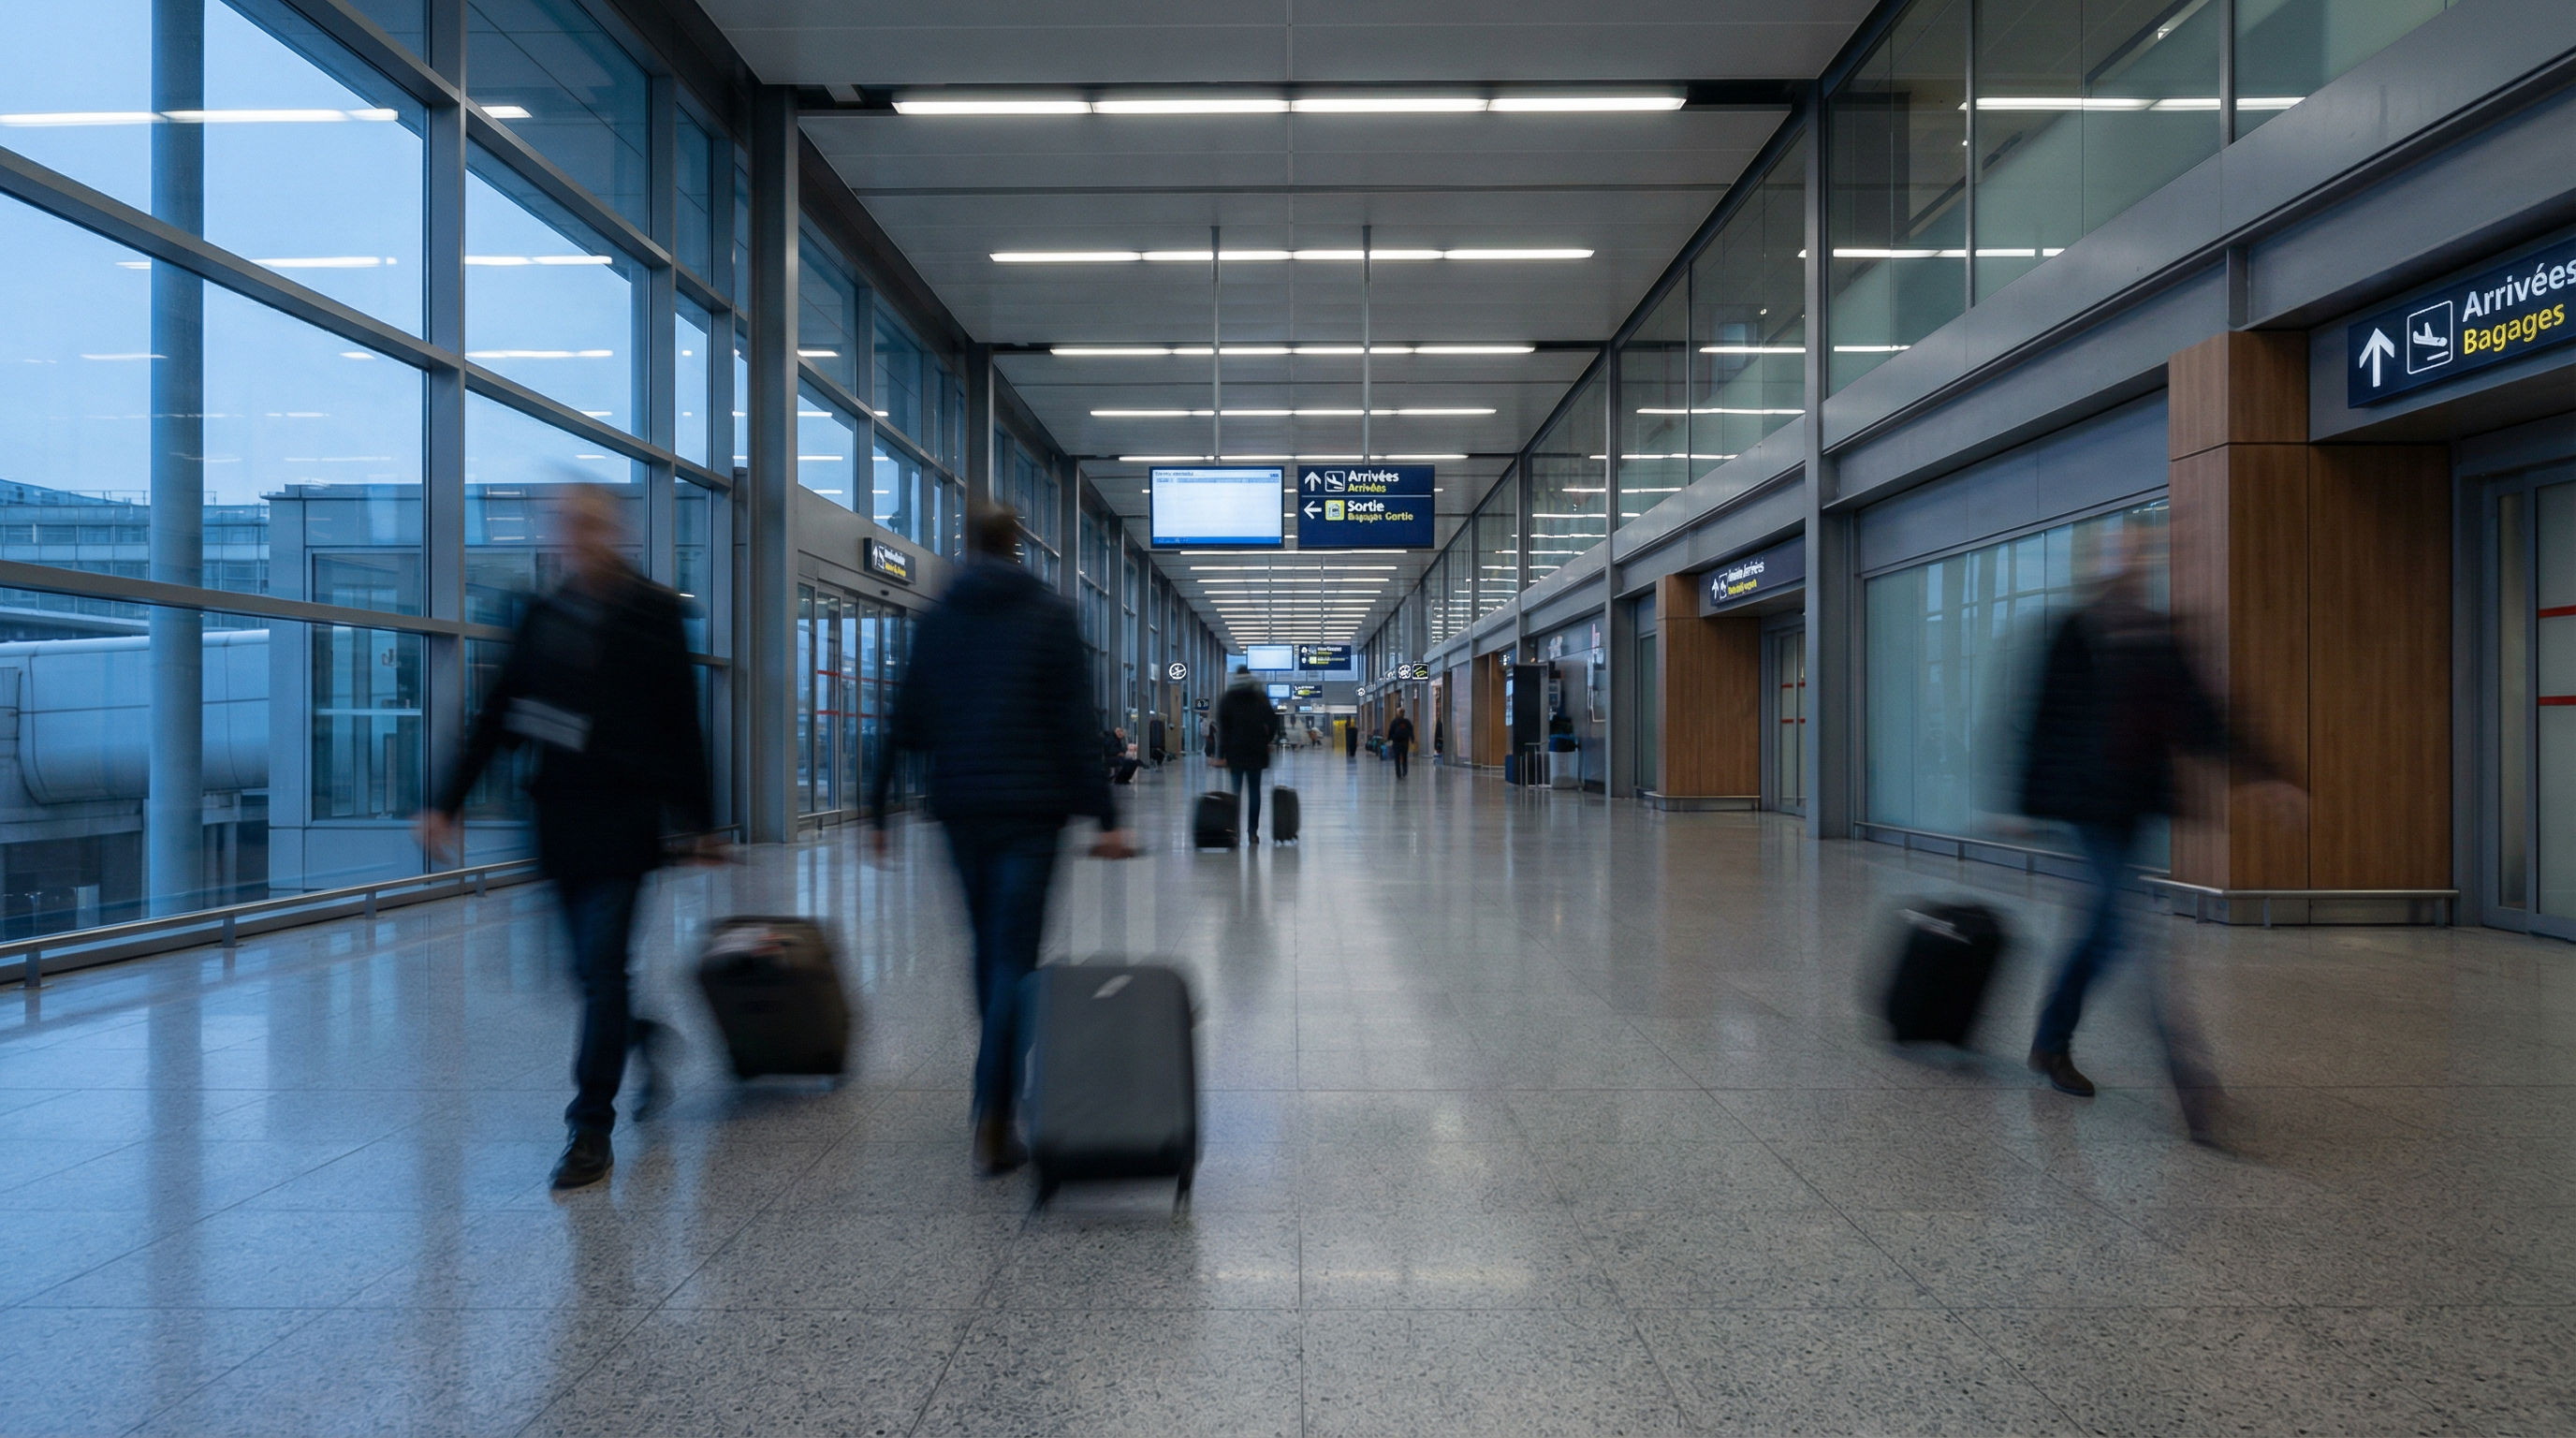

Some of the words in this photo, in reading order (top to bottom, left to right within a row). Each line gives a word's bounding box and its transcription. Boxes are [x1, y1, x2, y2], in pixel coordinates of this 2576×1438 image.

[2463, 259, 2576, 322] Arrivées
[2465, 303, 2565, 355] Bagages
[1348, 469, 1399, 482] Arrivées
[1348, 499, 1384, 512] Sortie
